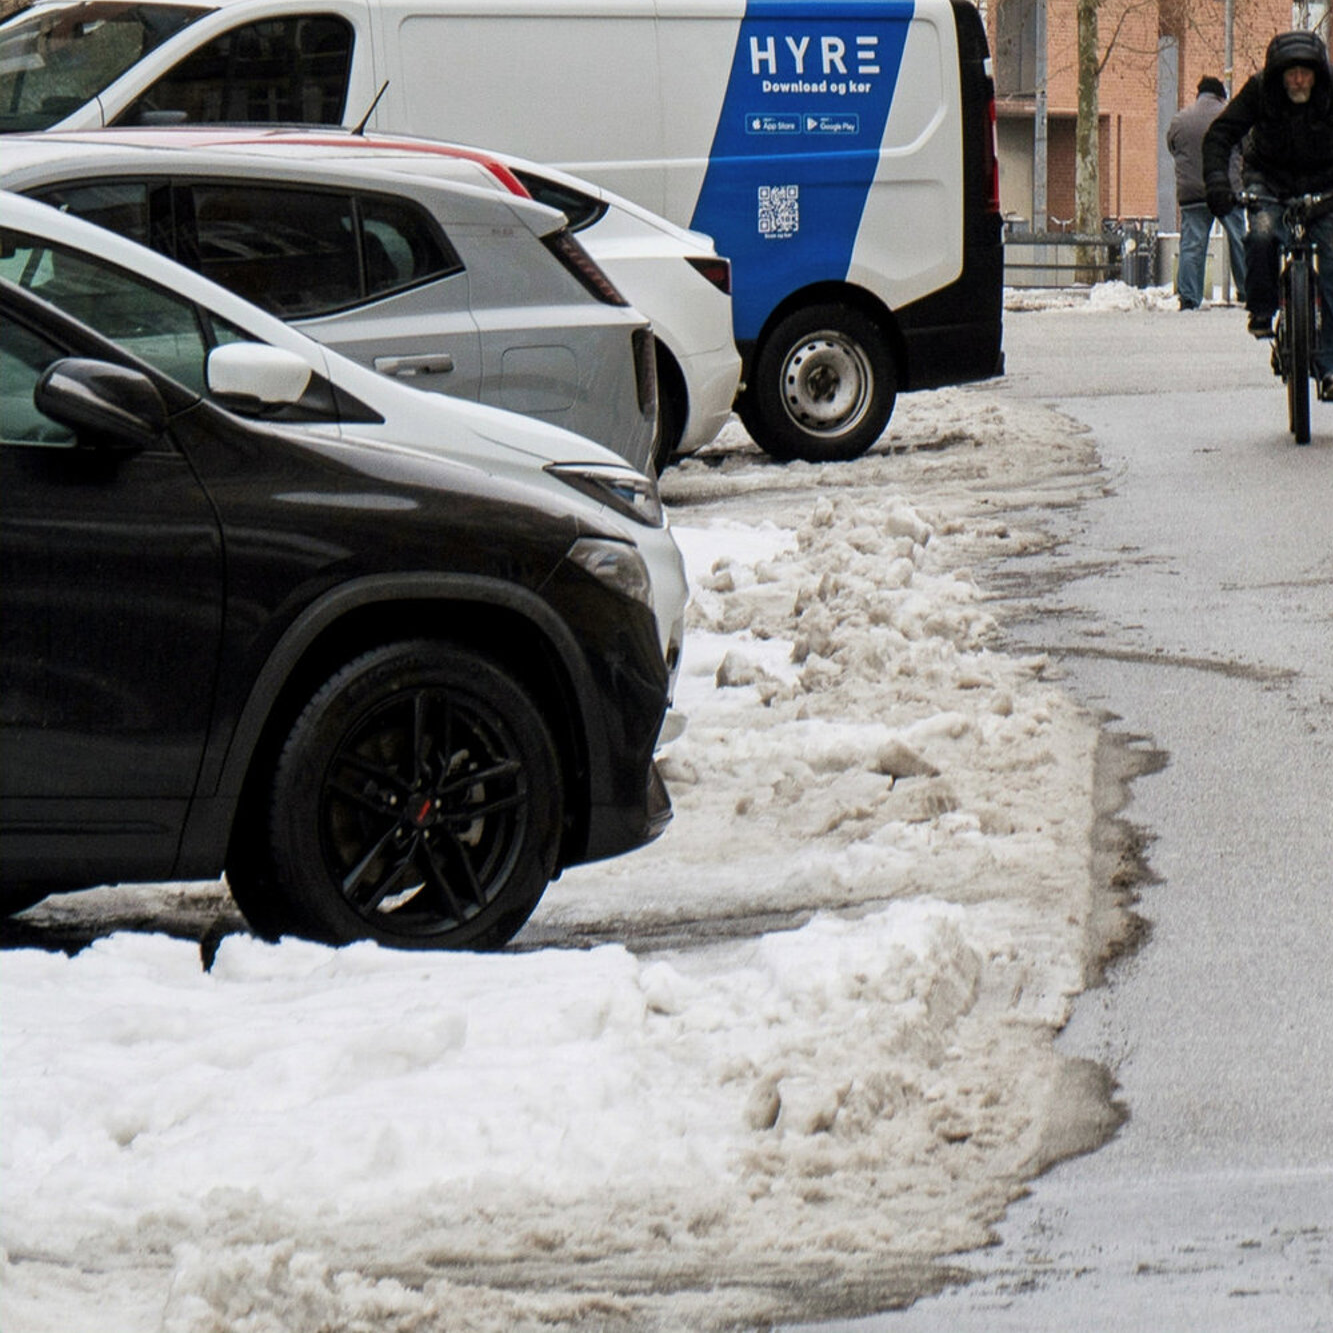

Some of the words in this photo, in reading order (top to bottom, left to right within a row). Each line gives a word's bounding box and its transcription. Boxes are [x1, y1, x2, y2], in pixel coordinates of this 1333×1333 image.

[750, 35, 880, 75] HYRE
[762, 80, 827, 93] Download
[830, 83, 846, 95] og
